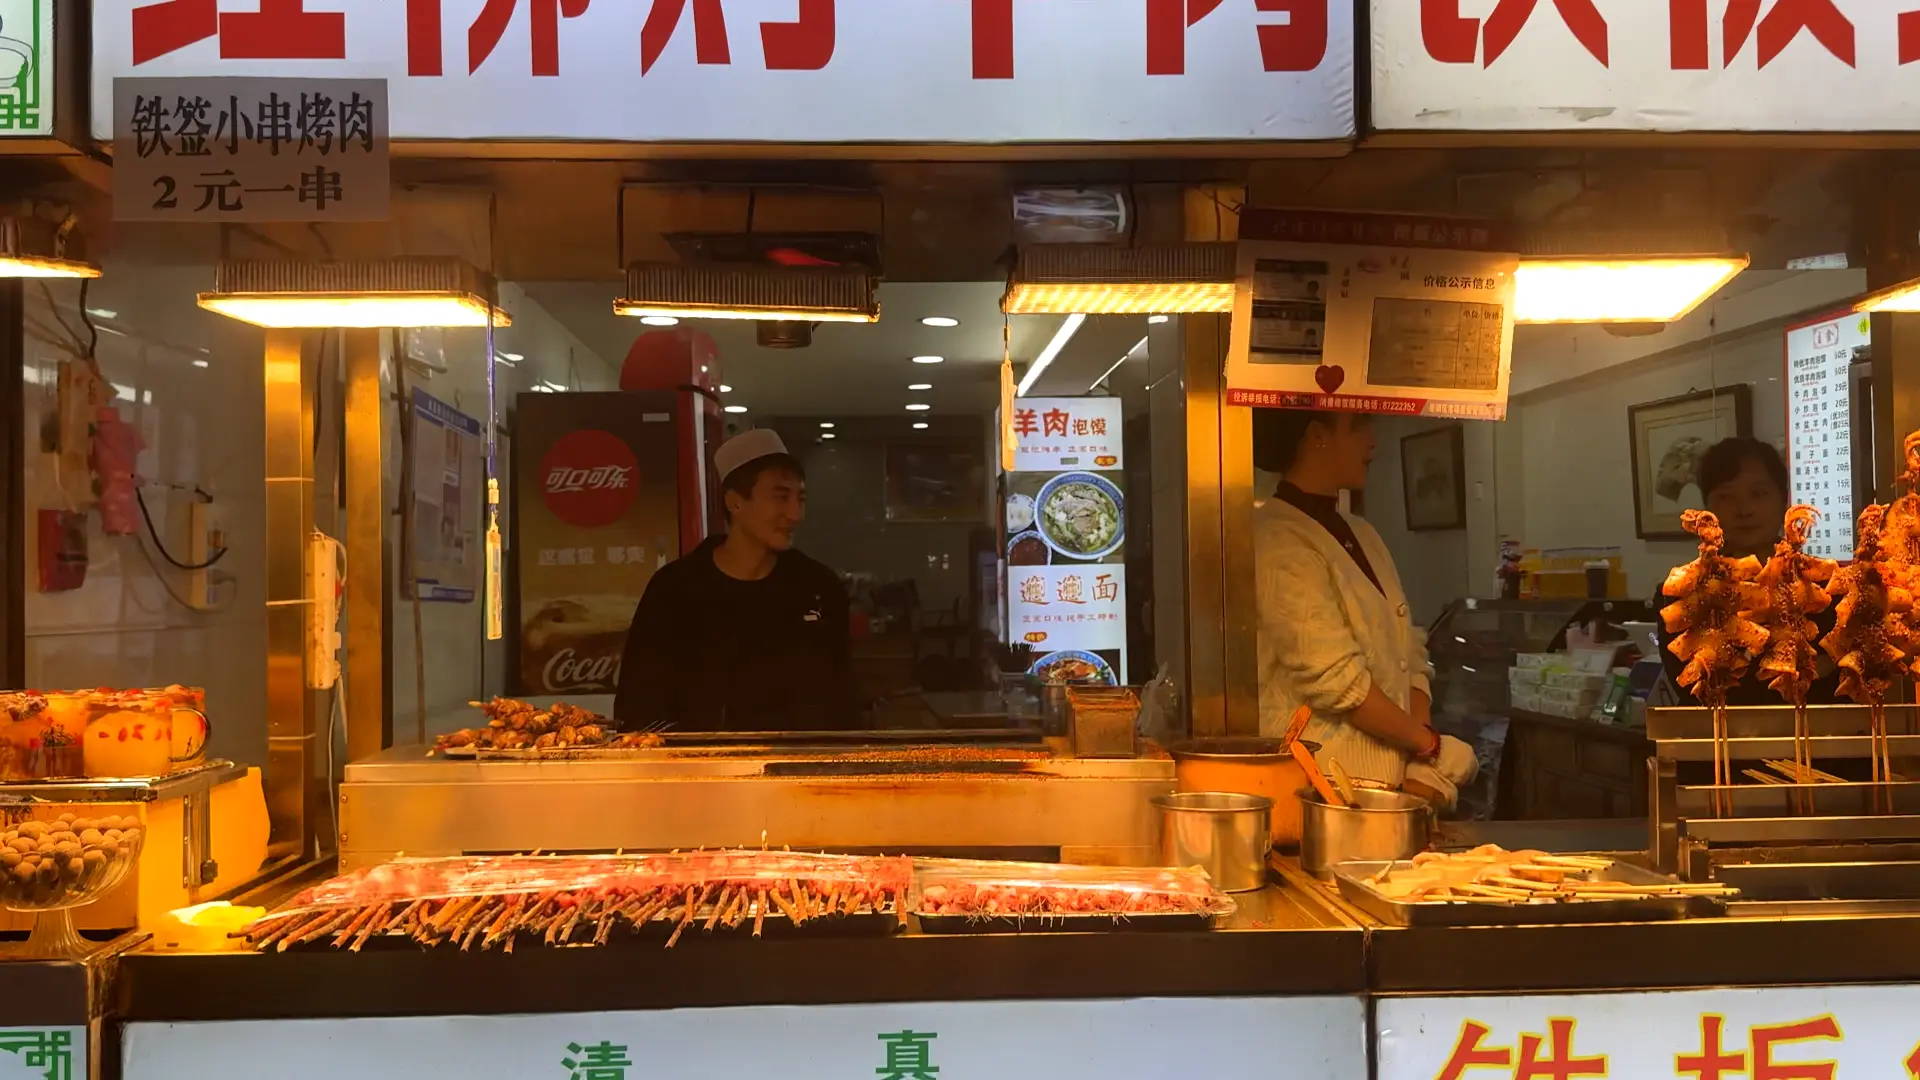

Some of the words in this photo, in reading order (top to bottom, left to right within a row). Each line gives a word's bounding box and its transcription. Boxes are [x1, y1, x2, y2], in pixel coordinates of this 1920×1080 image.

[130, 91, 374, 160] 铁签小串烤肉
[152, 166, 344, 212] 2元一串
[1423, 274, 1496, 291] 价格公示信息
[546, 464, 633, 493] 可口可乐
